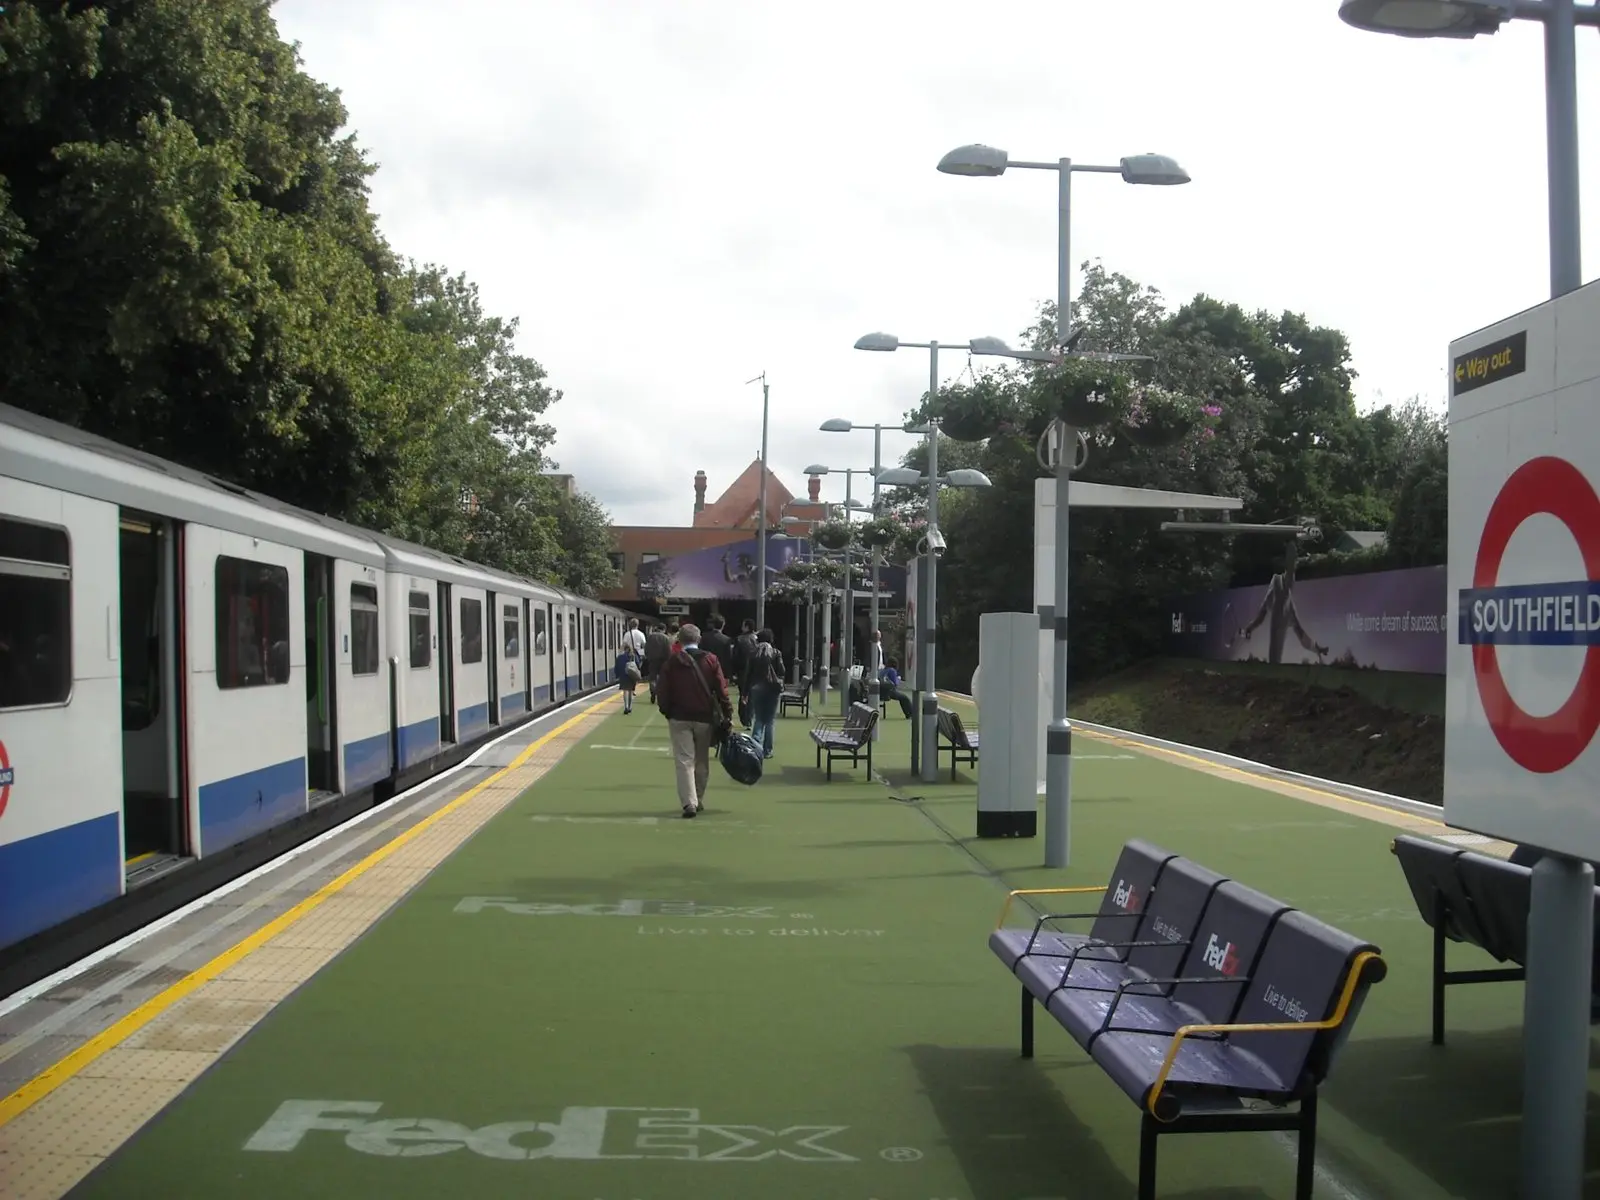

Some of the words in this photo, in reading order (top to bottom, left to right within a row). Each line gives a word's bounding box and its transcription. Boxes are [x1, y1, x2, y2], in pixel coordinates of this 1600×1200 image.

[1466, 357, 1489, 379] Way
[1491, 346, 1512, 370] out
[721, 926, 755, 936] to
[1263, 984, 1280, 1007] Live
[241, 1098, 860, 1162] FedEx
